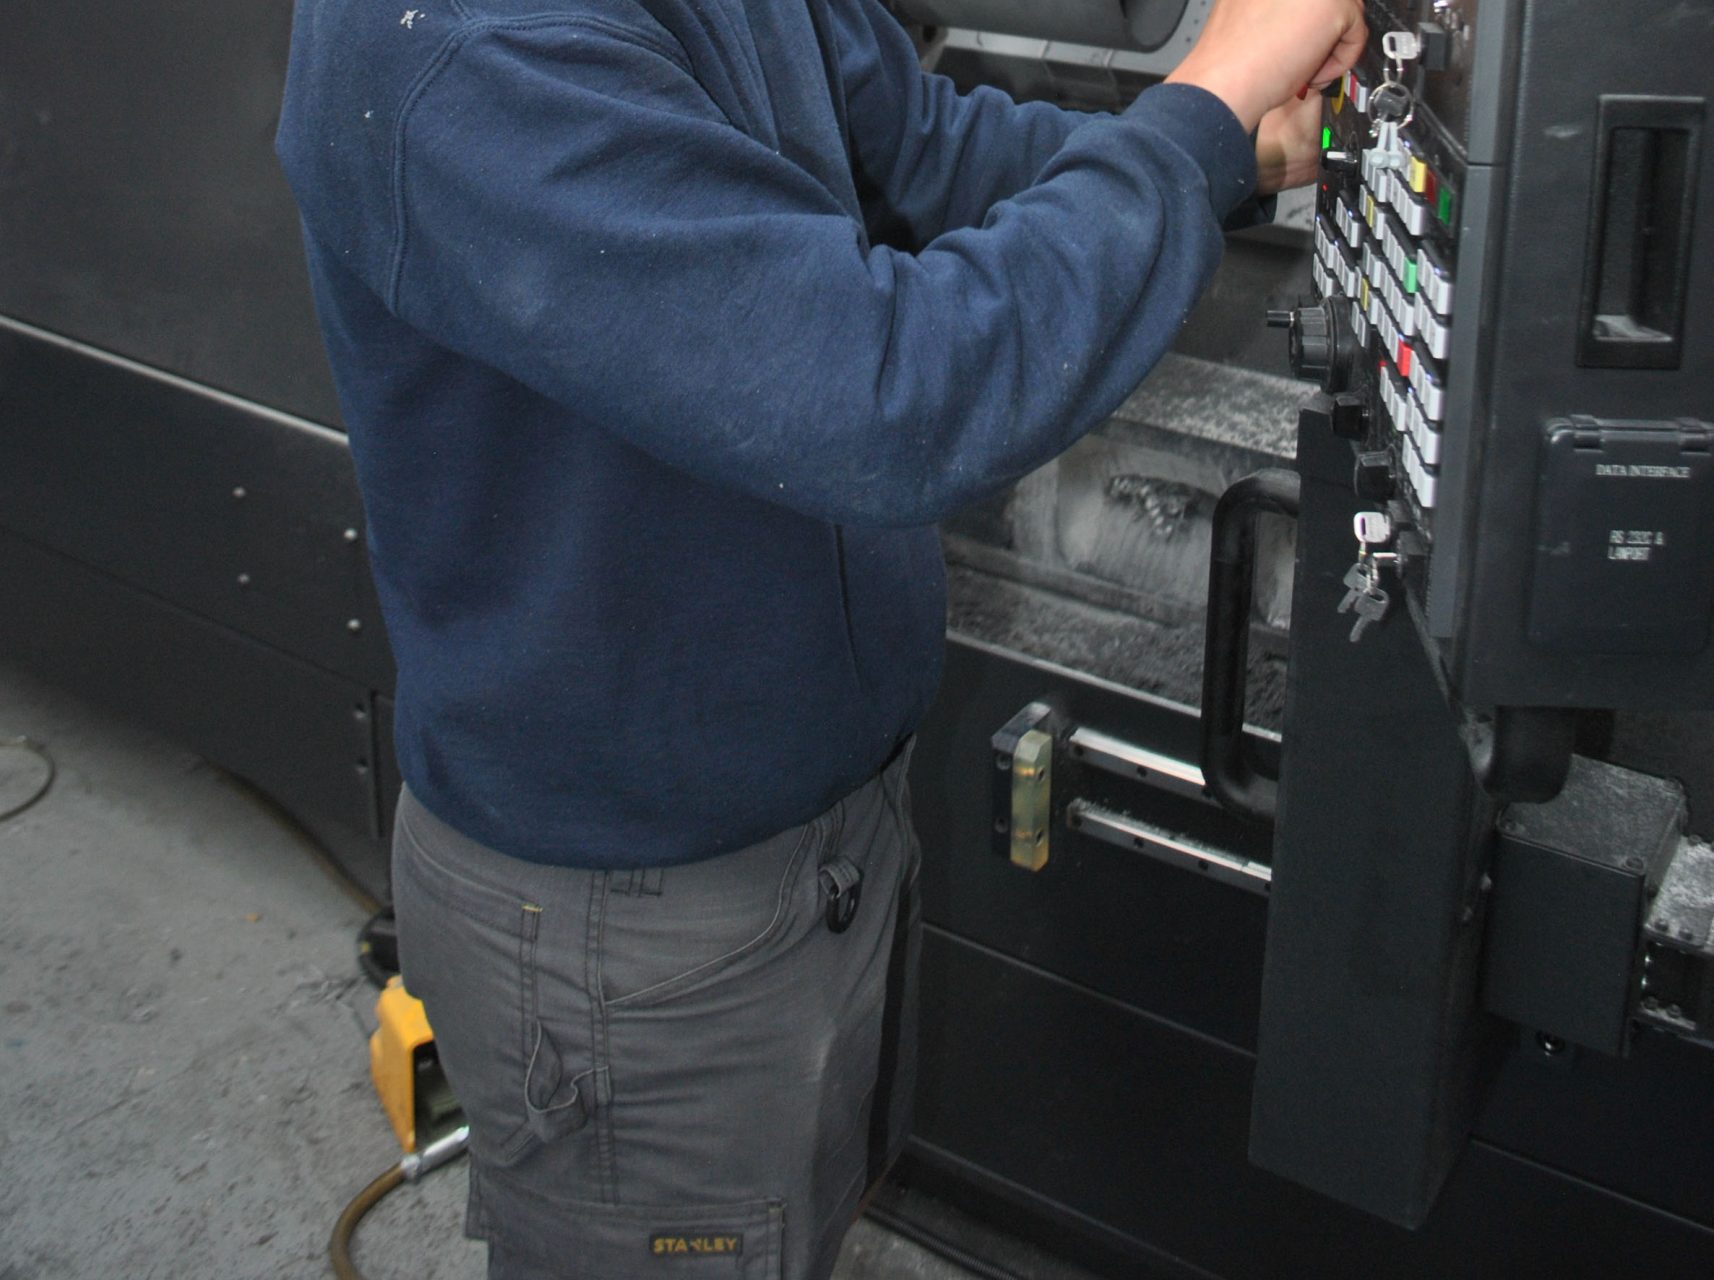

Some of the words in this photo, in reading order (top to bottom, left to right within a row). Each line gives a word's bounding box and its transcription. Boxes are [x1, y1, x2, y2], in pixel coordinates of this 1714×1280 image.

[1596, 464, 1627, 476] DATA
[1628, 465, 1691, 478] INTERFACE
[654, 1237, 737, 1254] STANLEY
